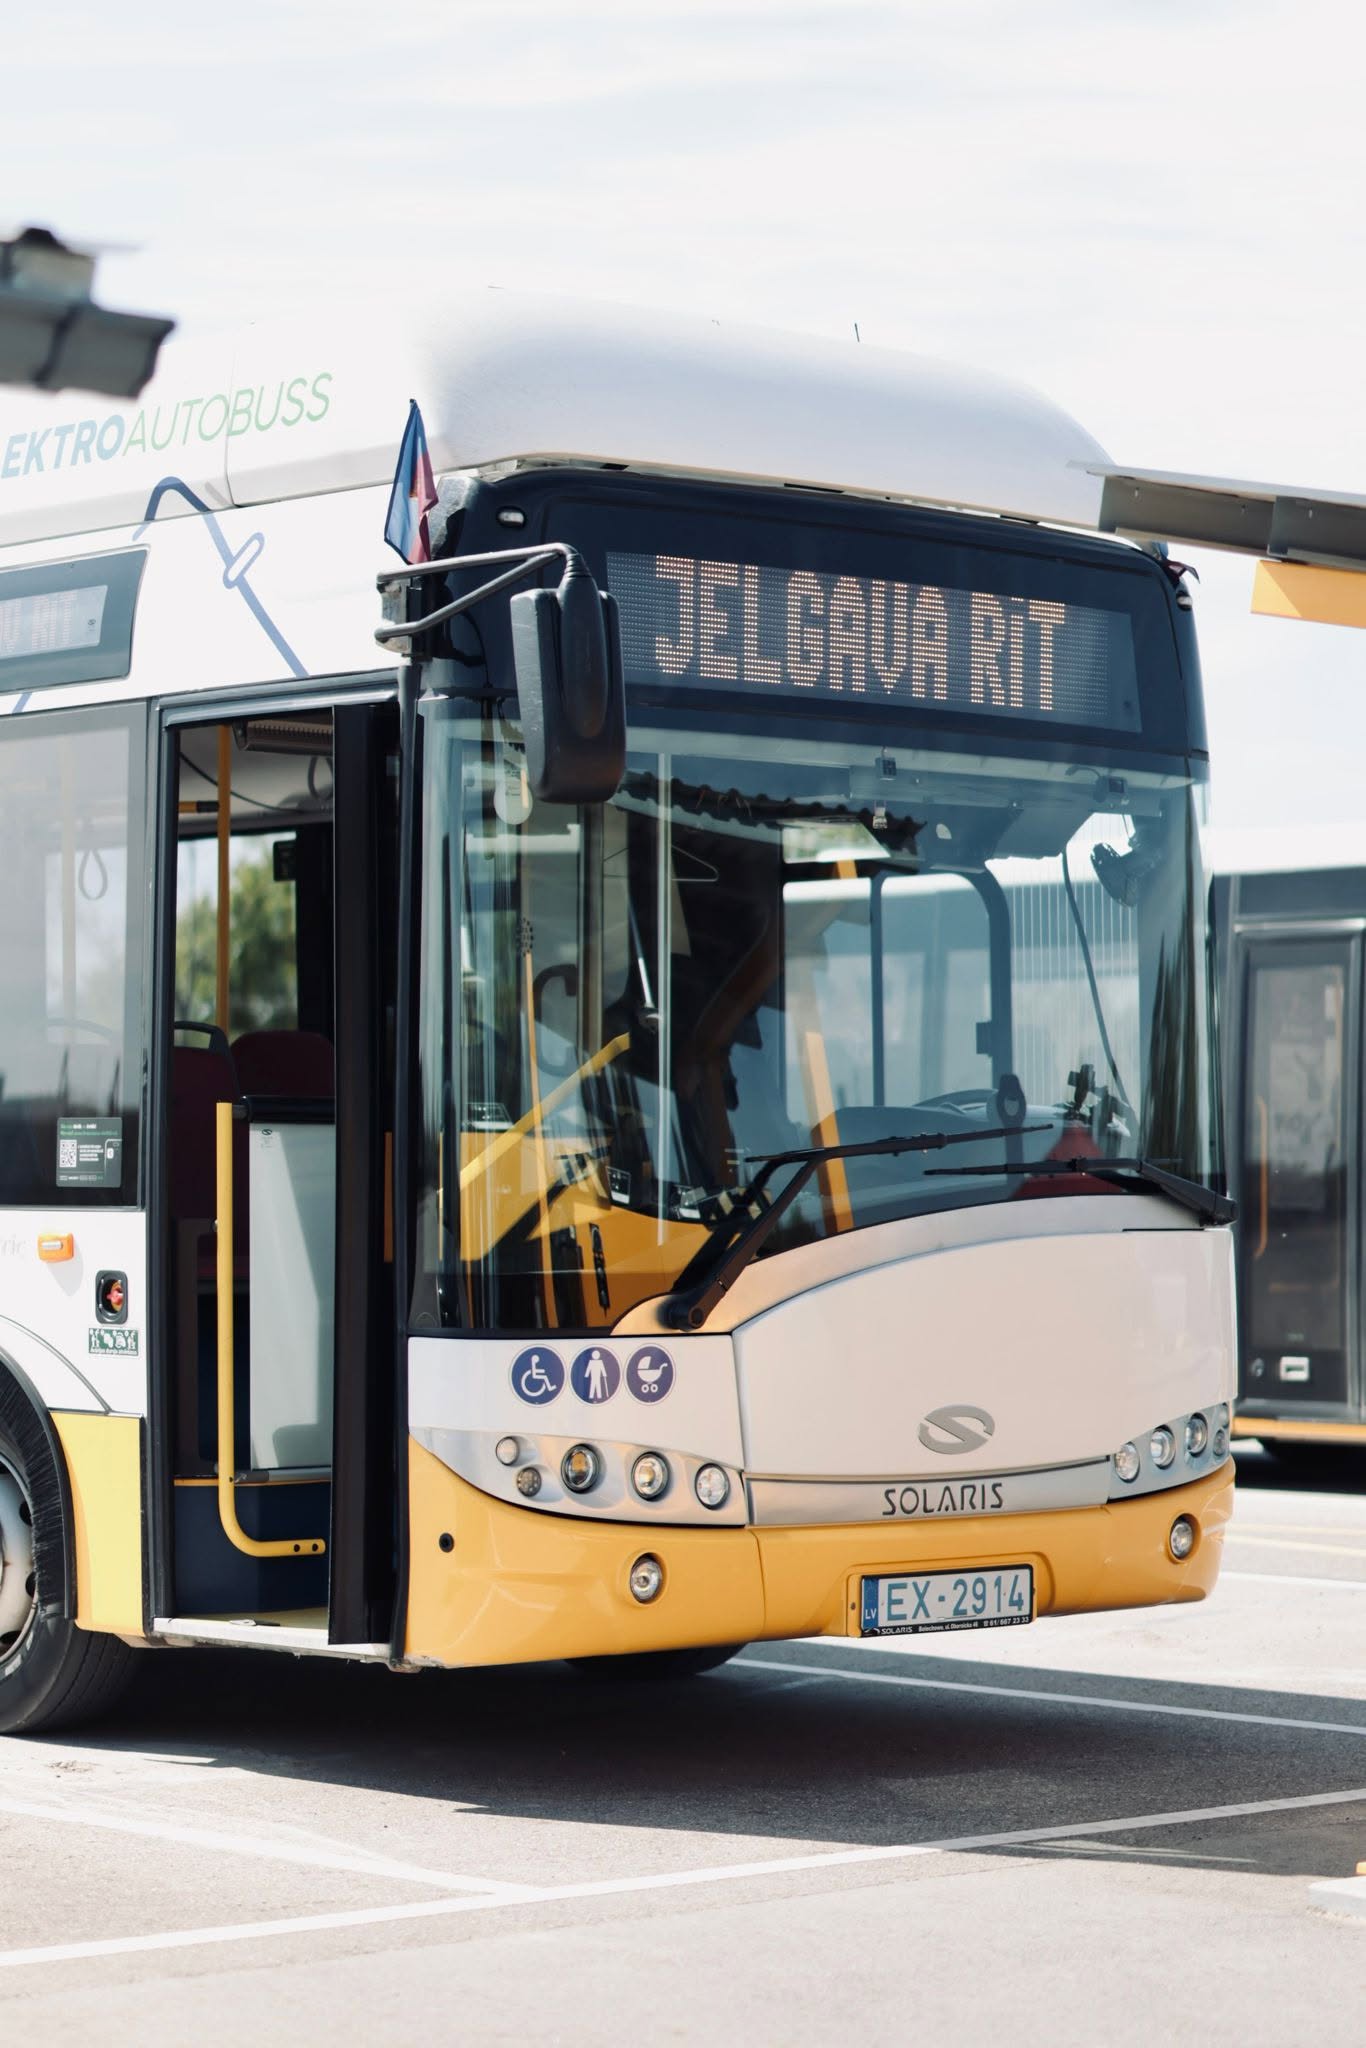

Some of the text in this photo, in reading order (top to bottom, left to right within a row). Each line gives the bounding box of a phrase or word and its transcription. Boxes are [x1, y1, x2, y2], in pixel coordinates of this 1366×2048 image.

[655, 555, 949, 701] JELGAVA
[882, 1482, 1004, 1516] SOLARIS
[865, 1608, 877, 1620] LV
[887, 1574, 1024, 1622] EX-2914
[881, 1626, 913, 1635] SOLARIS
